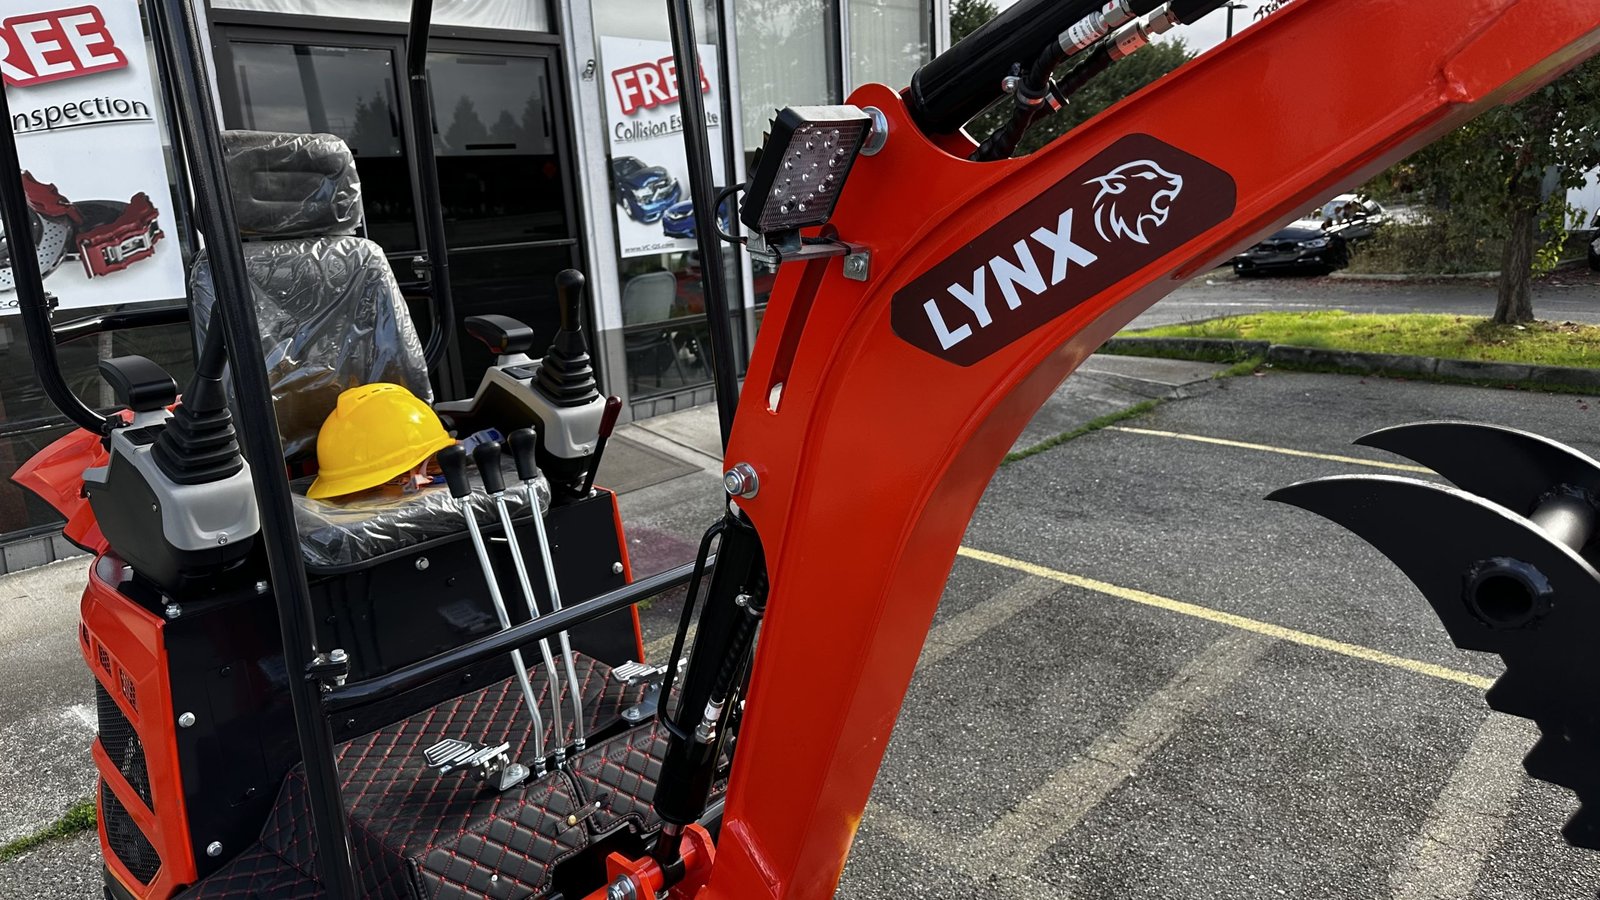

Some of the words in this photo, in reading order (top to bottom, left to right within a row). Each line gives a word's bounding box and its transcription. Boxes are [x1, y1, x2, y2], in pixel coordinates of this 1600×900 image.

[614, 59, 706, 112] FRE
[12, 96, 149, 131] nspection
[615, 118, 668, 141] Collision
[923, 207, 1098, 351] LYNX
